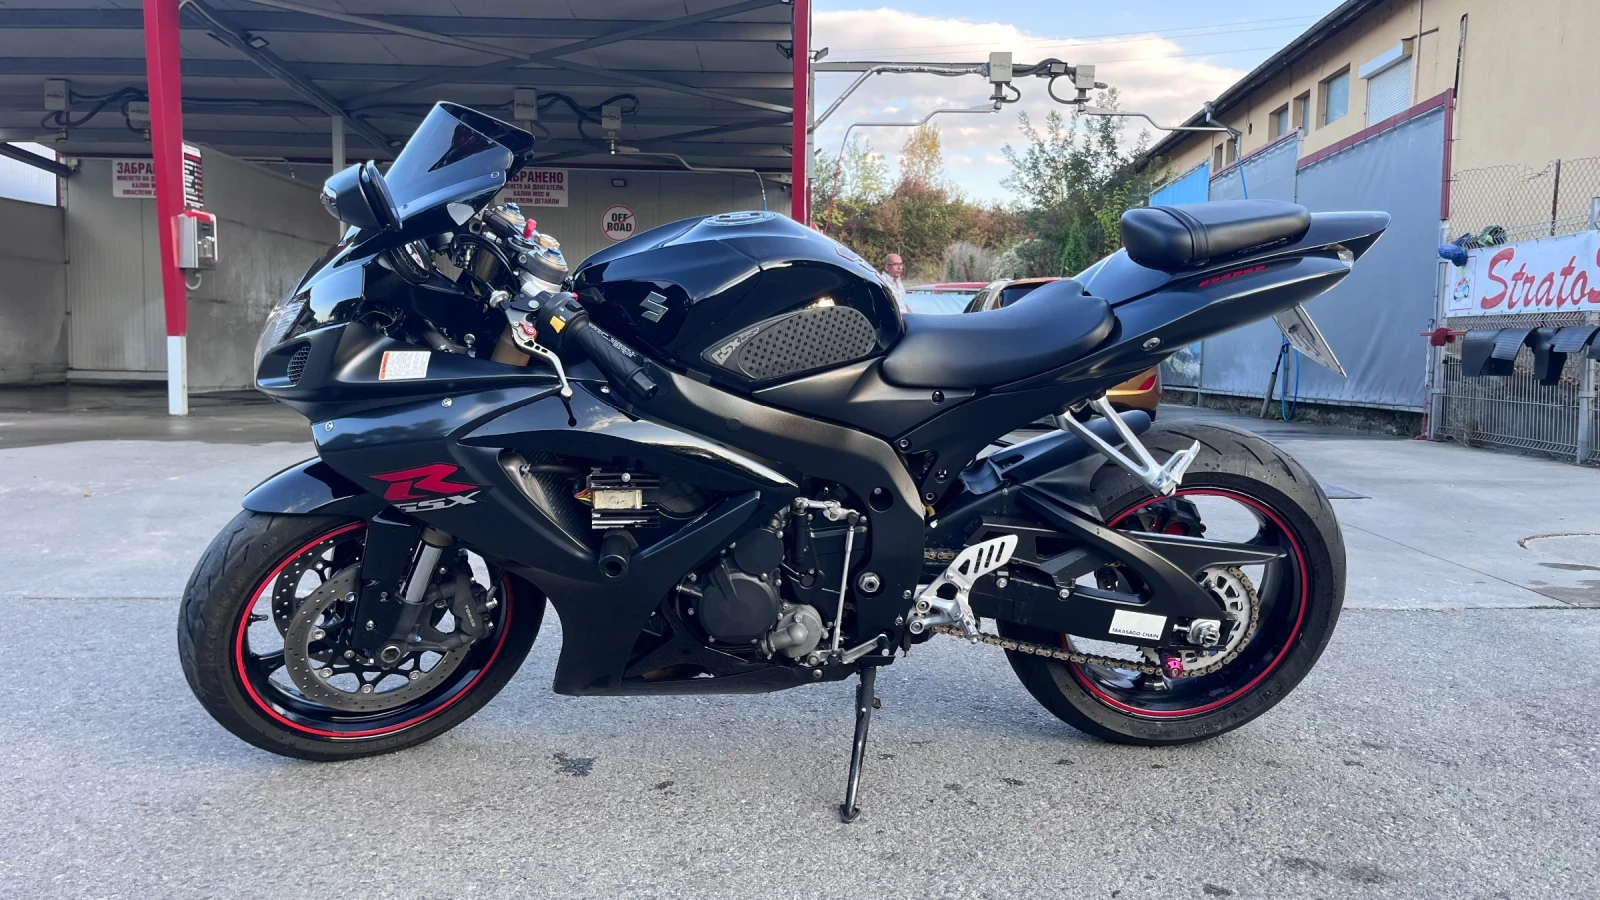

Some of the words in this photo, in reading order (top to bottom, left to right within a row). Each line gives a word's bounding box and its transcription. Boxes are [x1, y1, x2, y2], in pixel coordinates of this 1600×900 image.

[611, 213, 628, 222] OFF
[607, 222, 632, 232] ROAD
[395, 490, 481, 513] GSX
[1112, 628, 1141, 636] TAKASAGO
